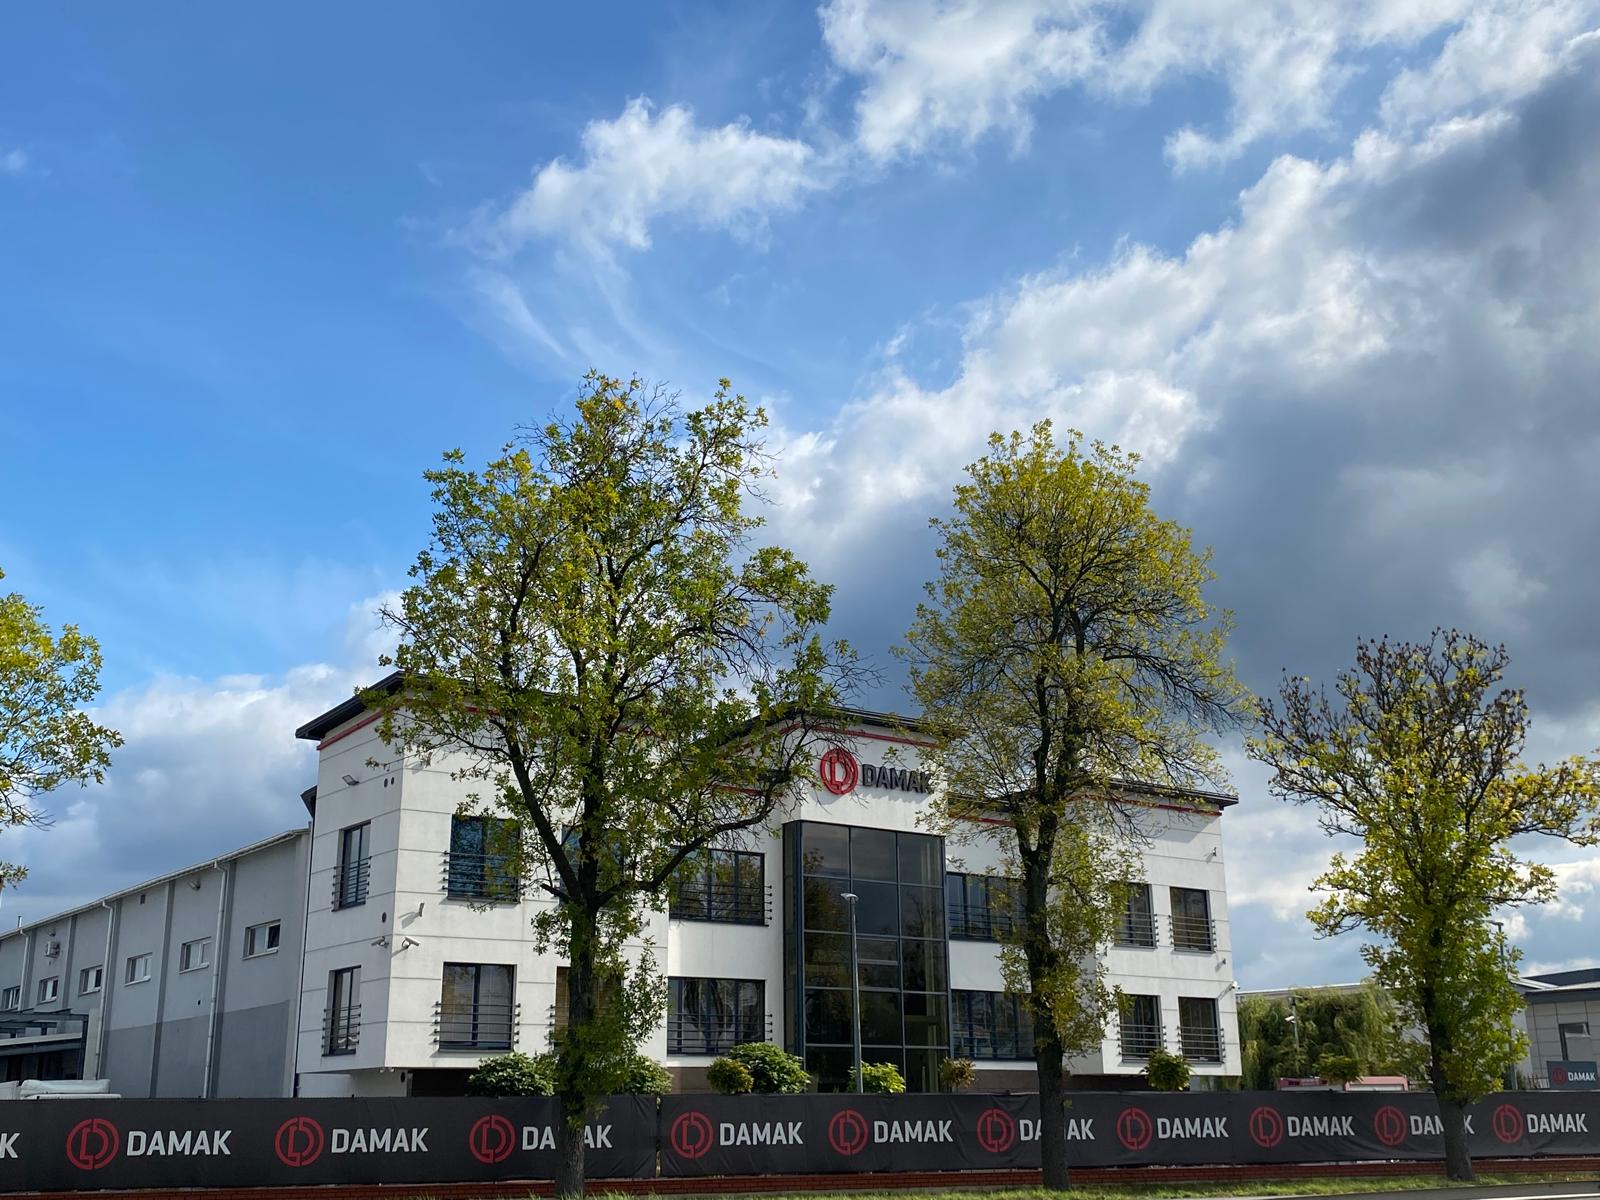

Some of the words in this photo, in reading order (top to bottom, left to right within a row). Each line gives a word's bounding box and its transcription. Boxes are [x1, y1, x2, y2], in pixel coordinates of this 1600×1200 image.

[1567, 1071, 1596, 1082] DAMAK
[720, 1122, 804, 1146] DAMAK
[873, 1120, 954, 1143] DAMAK
[1156, 1117, 1229, 1139] DAMAK
[1287, 1116, 1355, 1137] DAMAK
[1409, 1115, 1475, 1135] DAMK
[1526, 1114, 1589, 1133] DAMAK
[126, 1130, 232, 1156] DAMAK
[331, 1128, 429, 1153] DAMAK
[522, 1125, 613, 1150] DAAK
